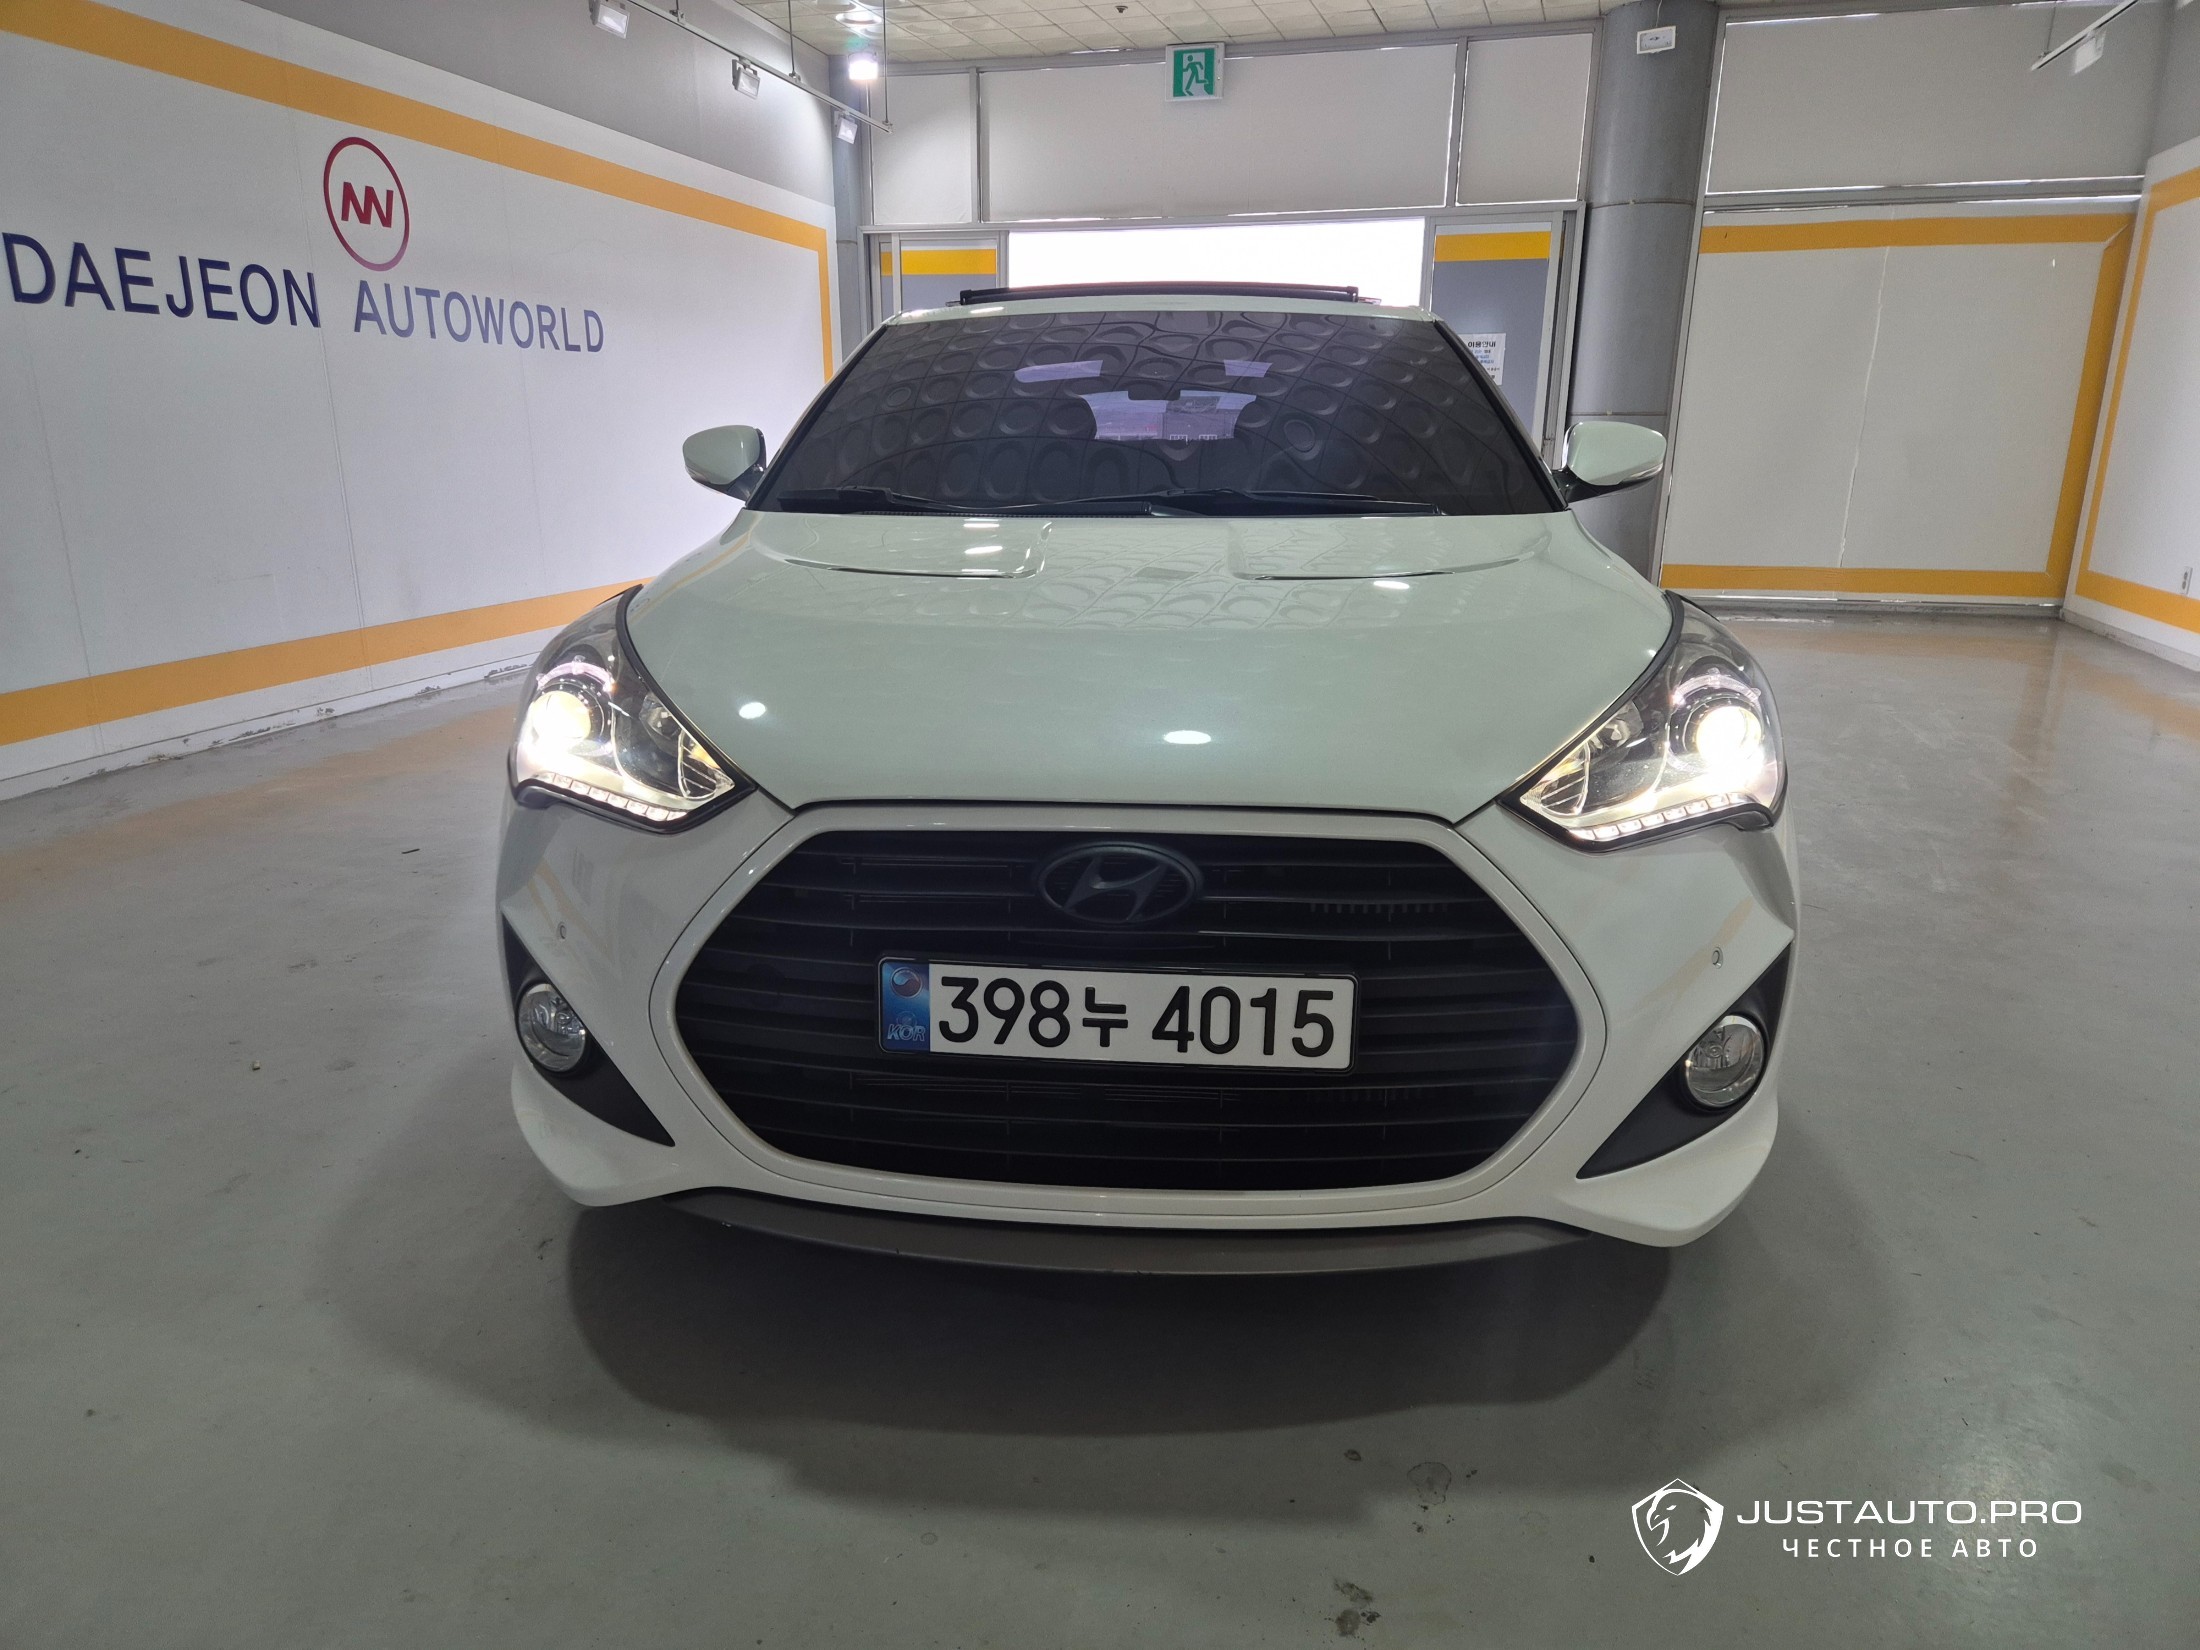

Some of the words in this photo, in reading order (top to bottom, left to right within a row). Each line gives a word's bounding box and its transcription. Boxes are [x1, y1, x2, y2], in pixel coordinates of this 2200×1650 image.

[2, 231, 321, 328] DAEJEON
[353, 279, 605, 353] AUTOWORLD
[887, 1023, 926, 1042] KOR
[938, 976, 1129, 1048] 398누
[1151, 985, 1335, 1058] 4015
